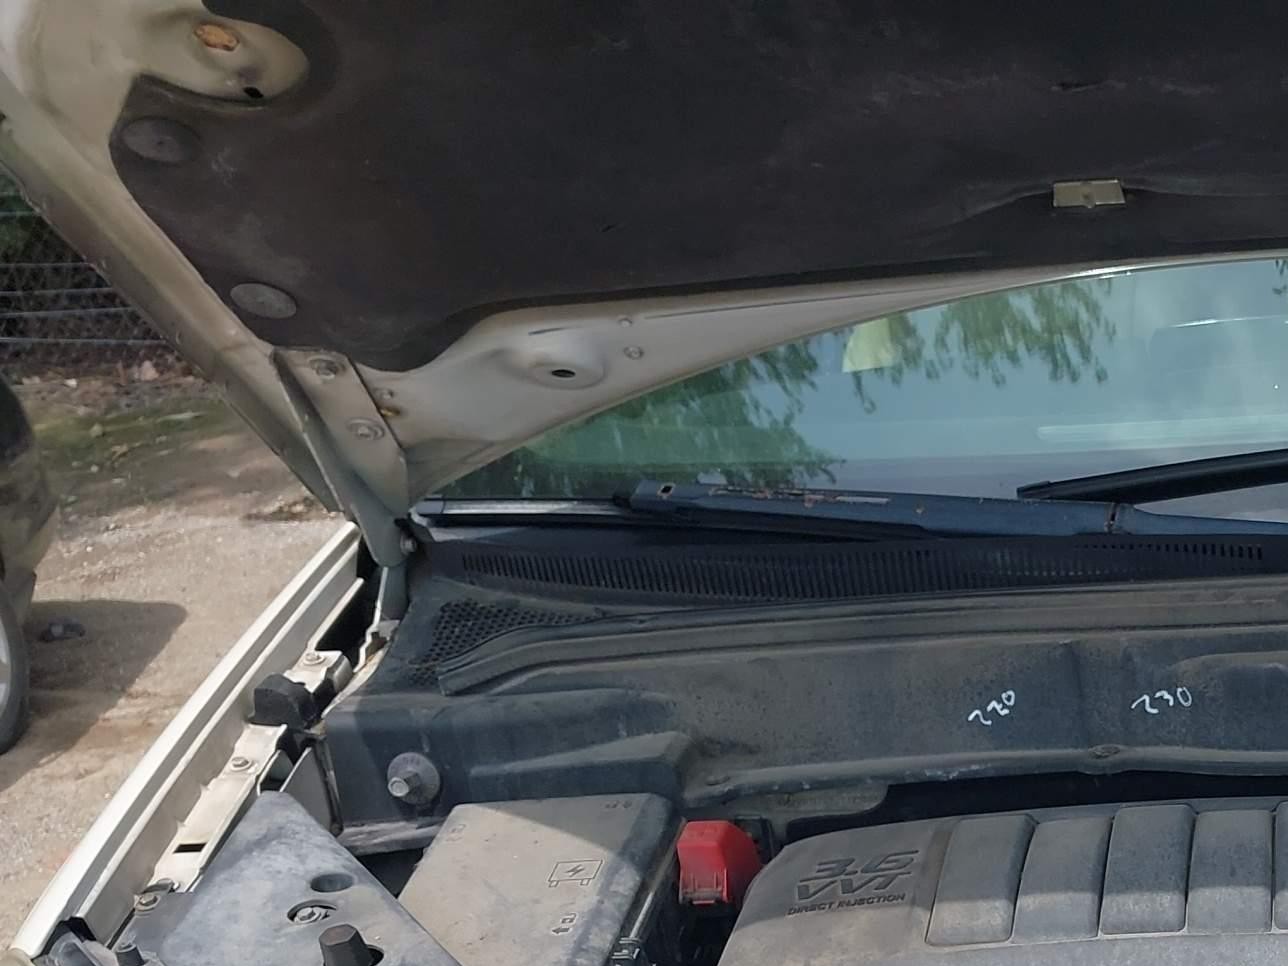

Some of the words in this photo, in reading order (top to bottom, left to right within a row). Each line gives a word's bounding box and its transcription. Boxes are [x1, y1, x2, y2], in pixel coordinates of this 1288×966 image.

[1131, 686, 1193, 714] 230
[800, 850, 919, 882] 3.6
[797, 872, 912, 900] VVT
[787, 902, 833, 916] DIRECT
[836, 893, 906, 908] INJECTION
